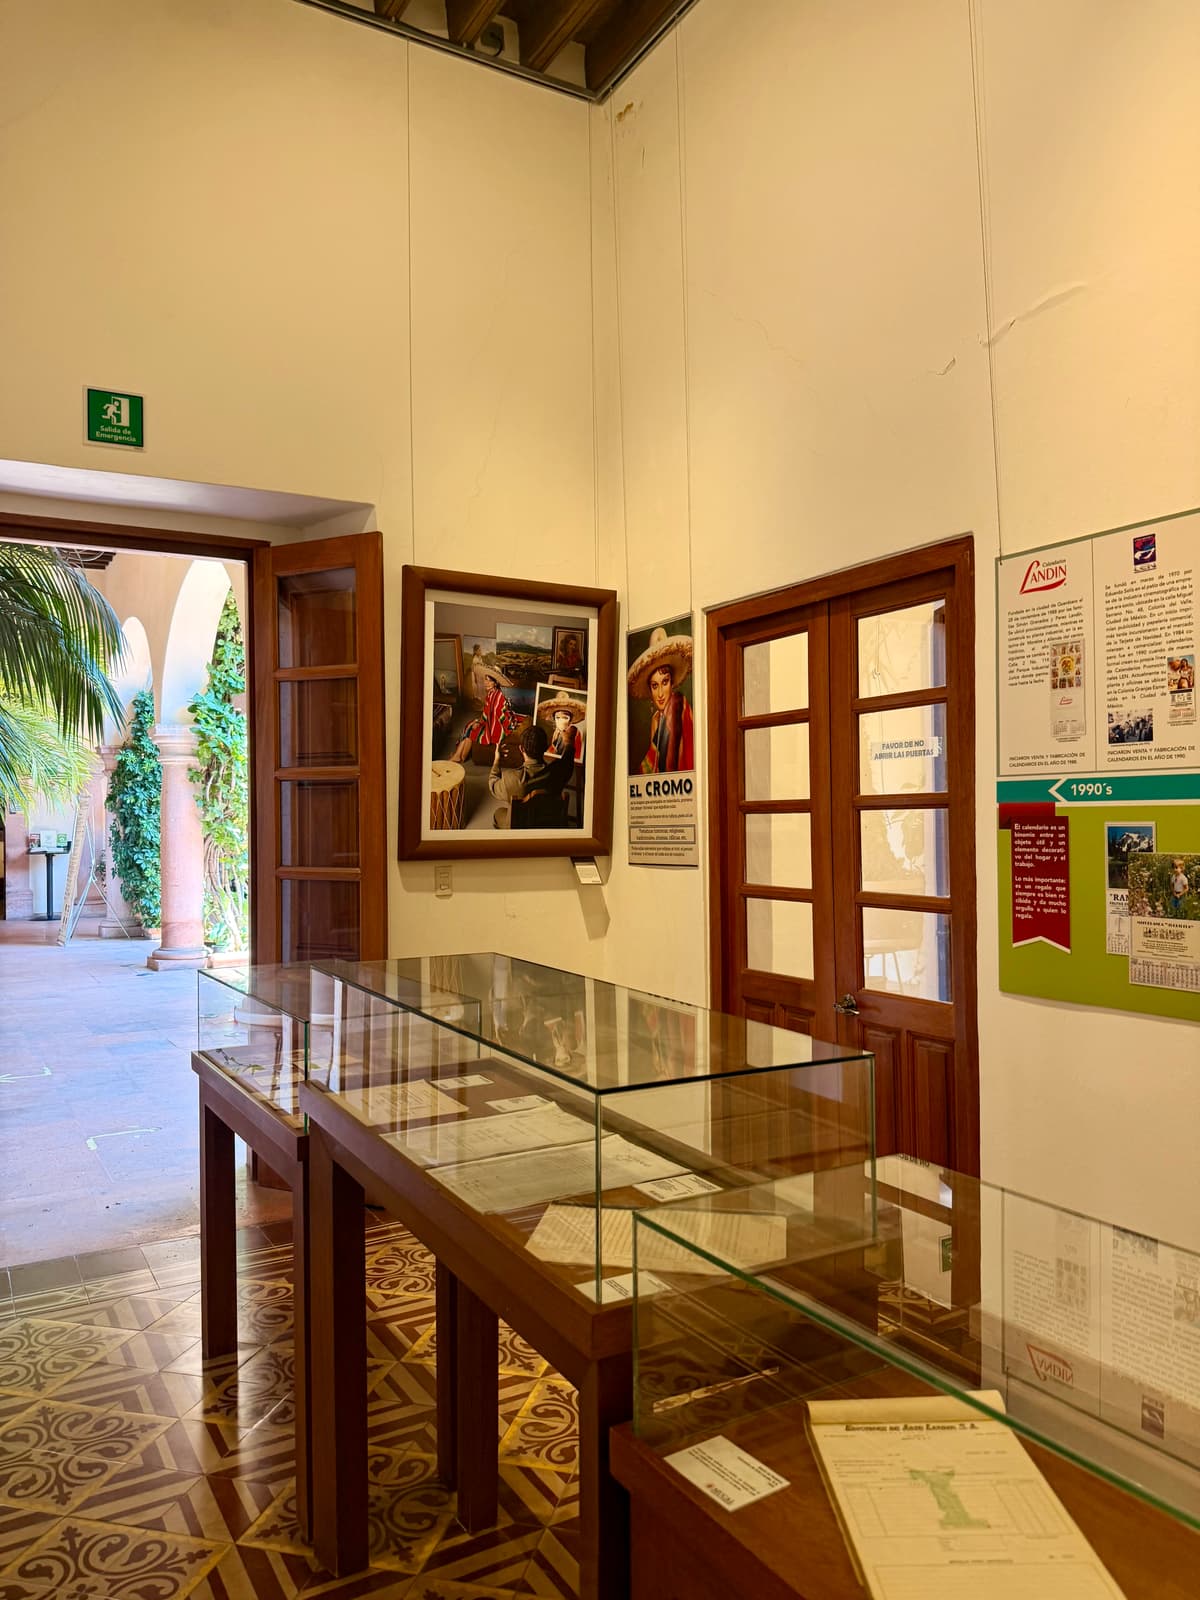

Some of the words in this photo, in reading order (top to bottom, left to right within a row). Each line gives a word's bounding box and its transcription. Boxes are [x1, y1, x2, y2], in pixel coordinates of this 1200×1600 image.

[100, 425, 121, 434] Salida
[96, 431, 136, 442] Emergencia
[881, 741, 903, 750] FAVOR
[903, 740, 913, 748] DE
[913, 739, 925, 747] NO
[905, 748, 934, 758] PUERTAS
[629, 784, 642, 798] EL
[645, 778, 693, 796] CROMO
